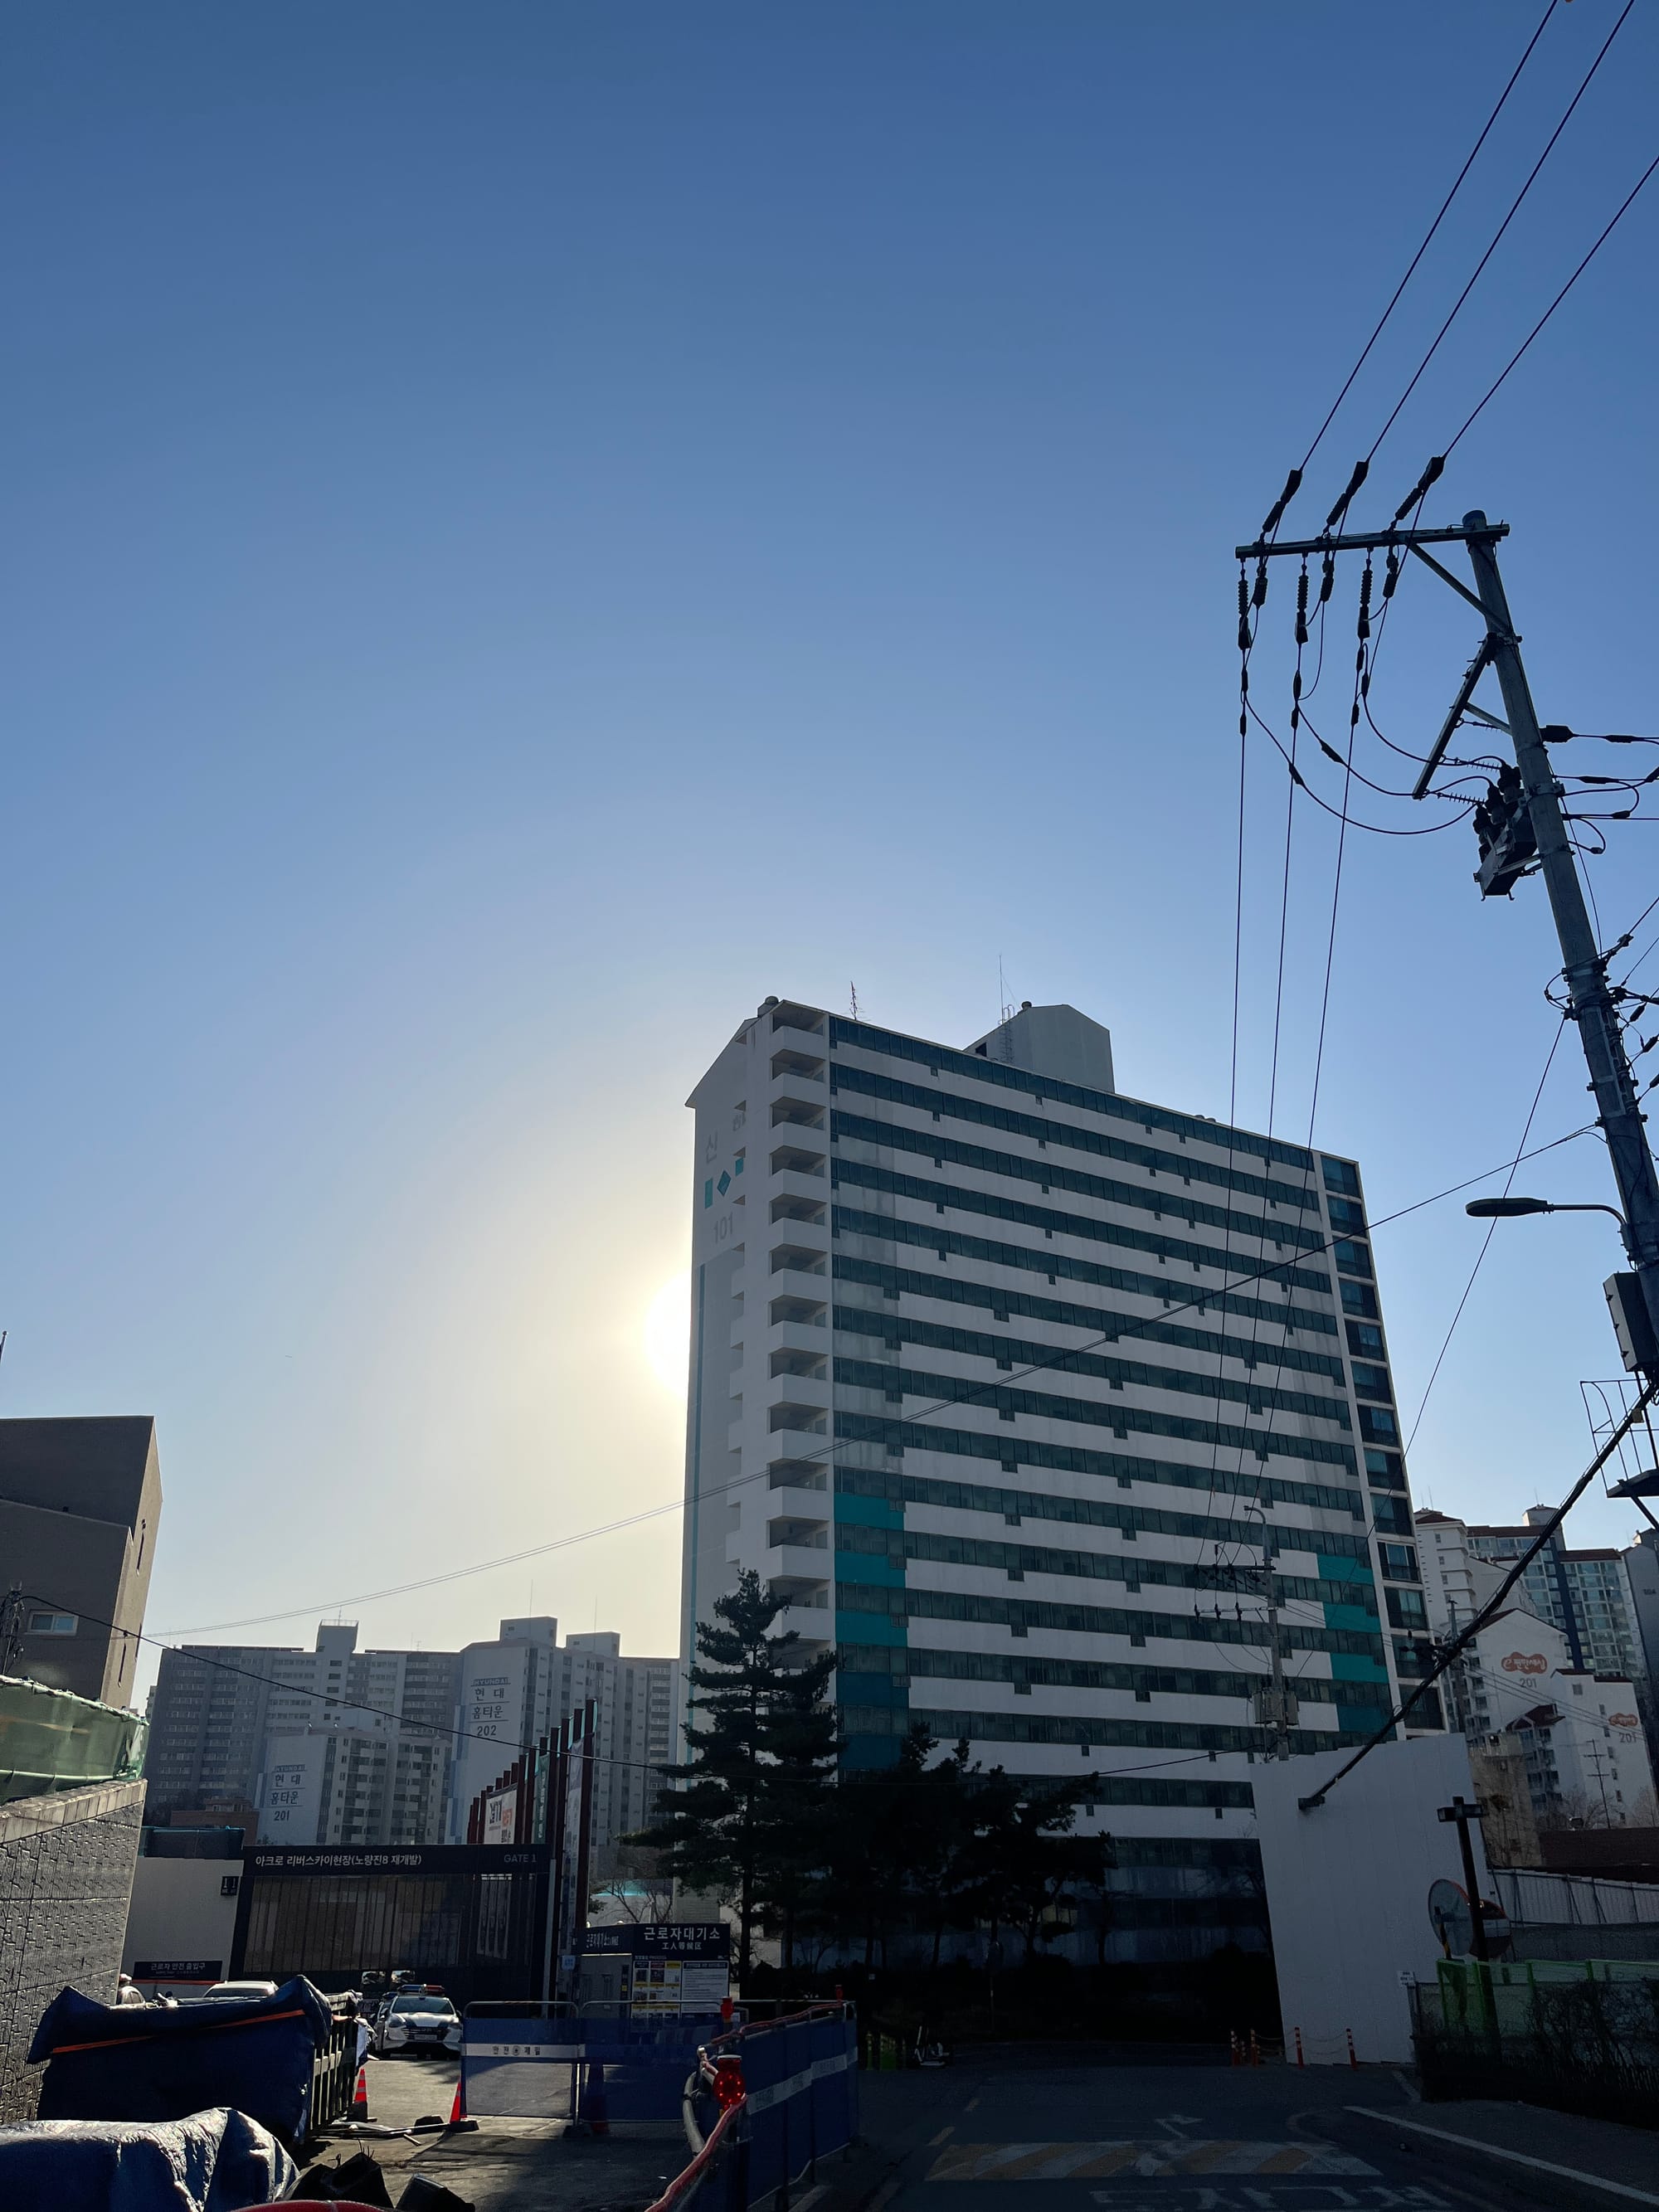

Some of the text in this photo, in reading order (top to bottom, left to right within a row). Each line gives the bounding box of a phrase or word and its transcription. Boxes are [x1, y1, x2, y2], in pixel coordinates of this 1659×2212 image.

[1520, 1678, 1538, 1689] 201
[477, 1725, 497, 1736] 202
[1619, 1733, 1637, 1743] 201
[274, 1810, 290, 1821] 201
[255, 1855, 284, 1867] 아크로
[391, 1854, 422, 1866] 재개발)
[504, 1854, 538, 1863] GATE 1
[644, 1927, 721, 1942] 근로자대기소
